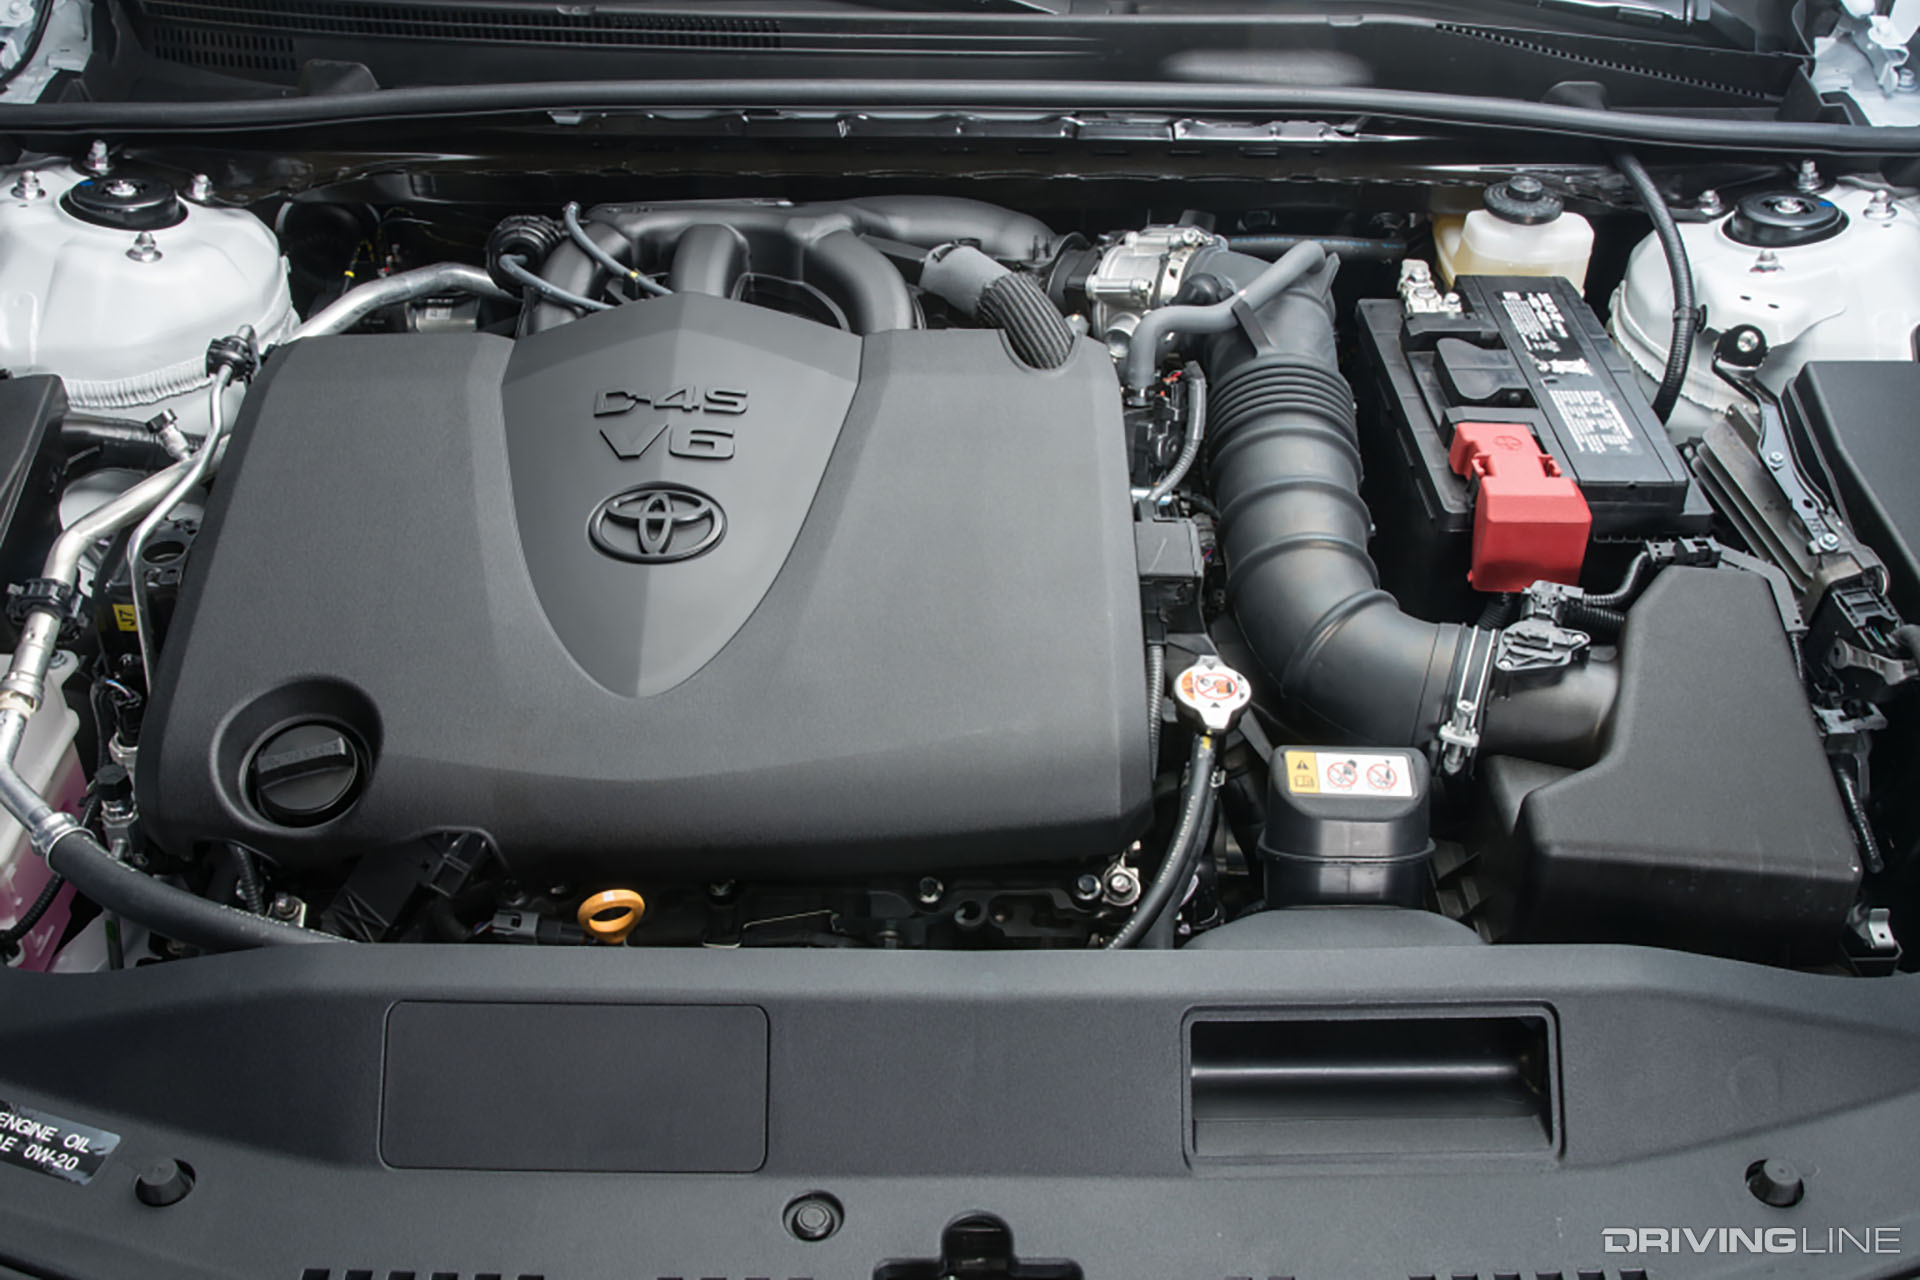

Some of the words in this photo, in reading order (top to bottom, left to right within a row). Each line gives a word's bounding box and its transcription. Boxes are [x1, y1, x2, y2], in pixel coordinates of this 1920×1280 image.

[594, 384, 748, 418] D-4S
[599, 422, 735, 461] V6
[0, 1111, 58, 1142] ENGINE
[63, 1133, 90, 1153] OIL
